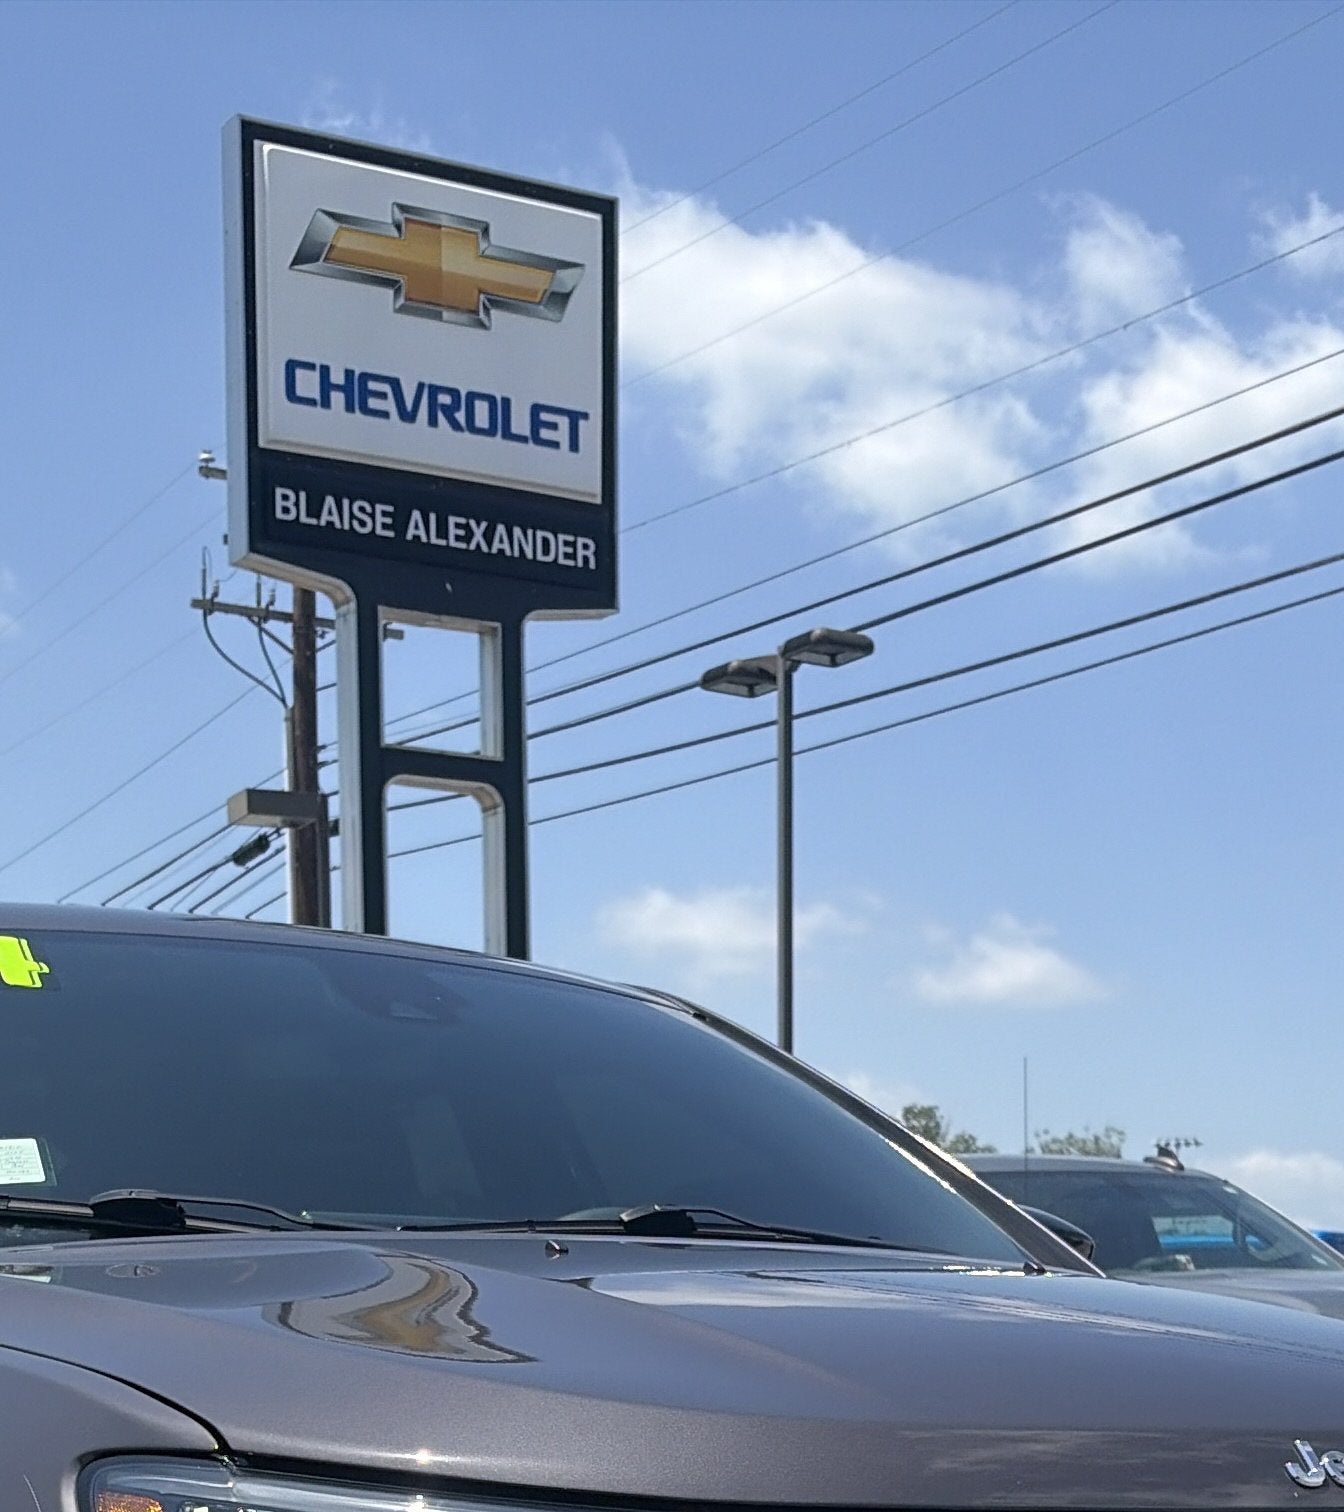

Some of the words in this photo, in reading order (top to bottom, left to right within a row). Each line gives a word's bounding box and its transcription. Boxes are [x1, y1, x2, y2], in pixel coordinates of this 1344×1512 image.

[284, 358, 589, 454] CHEVROLET
[274, 486, 395, 539] BLAISE
[405, 508, 597, 571] ALEXANDER
